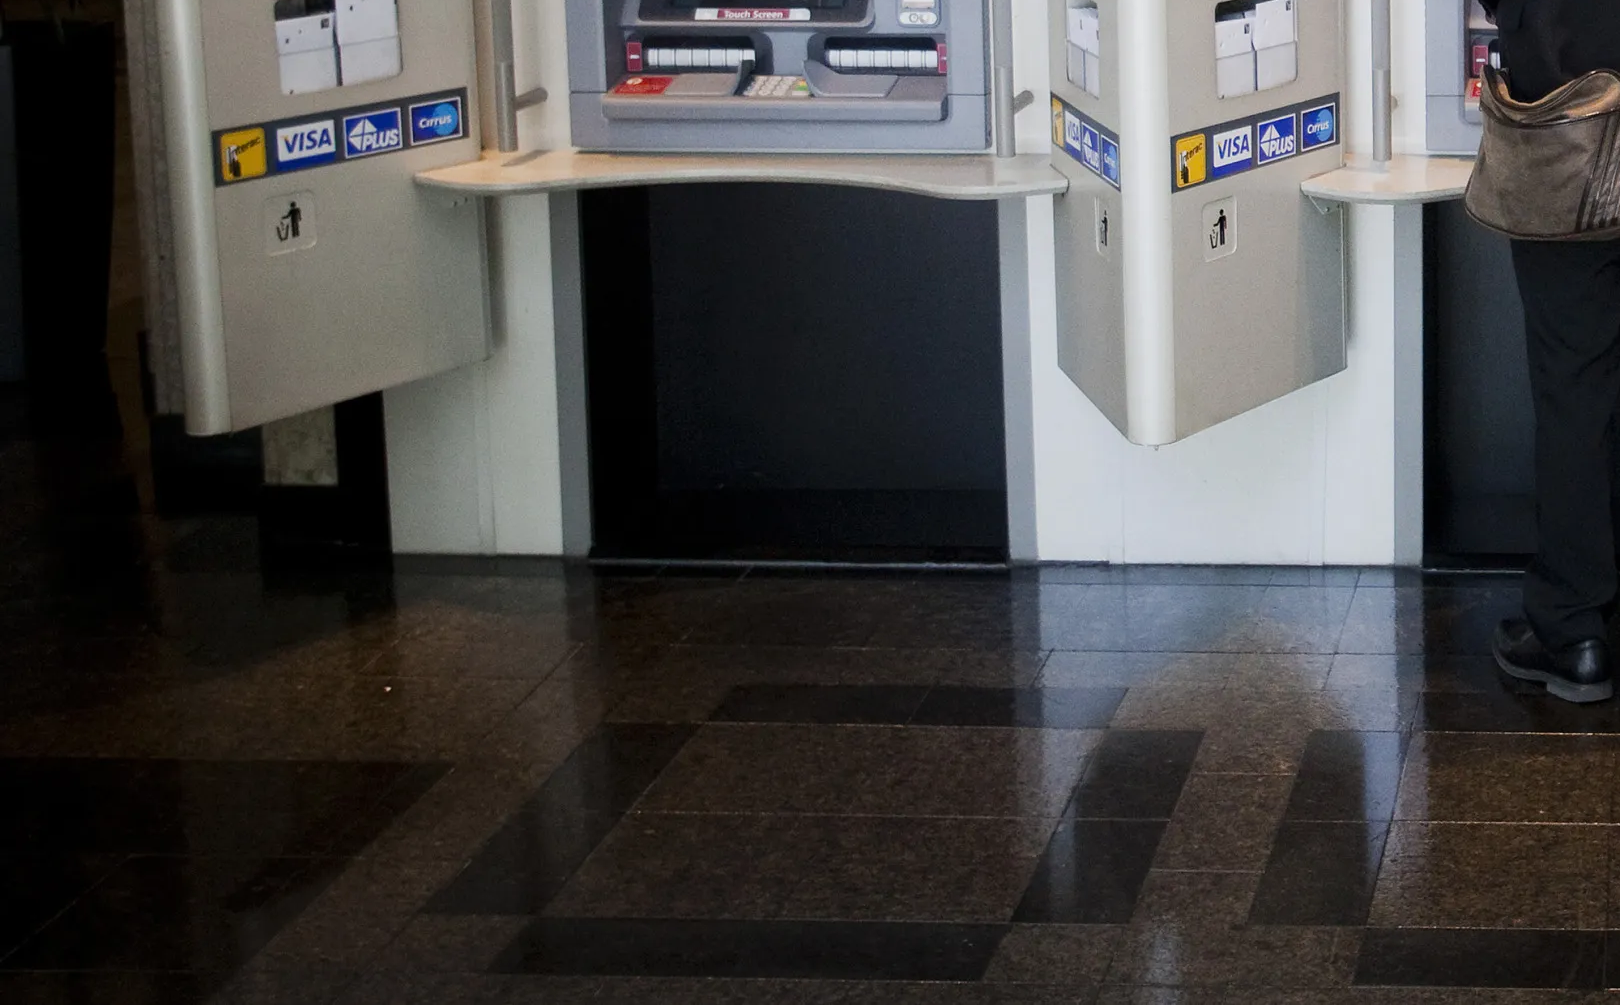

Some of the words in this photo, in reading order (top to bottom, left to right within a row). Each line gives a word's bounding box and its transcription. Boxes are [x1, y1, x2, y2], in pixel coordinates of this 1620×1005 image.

[724, 10, 750, 19] Touch
[753, 10, 783, 19] Screen
[283, 128, 332, 154] VISA
[361, 129, 399, 151] PLUS
[419, 115, 452, 129] Cirrus
[1217, 134, 1249, 160] VISA
[1269, 135, 1294, 157] PLUS
[1307, 120, 1330, 135] Cirrus
